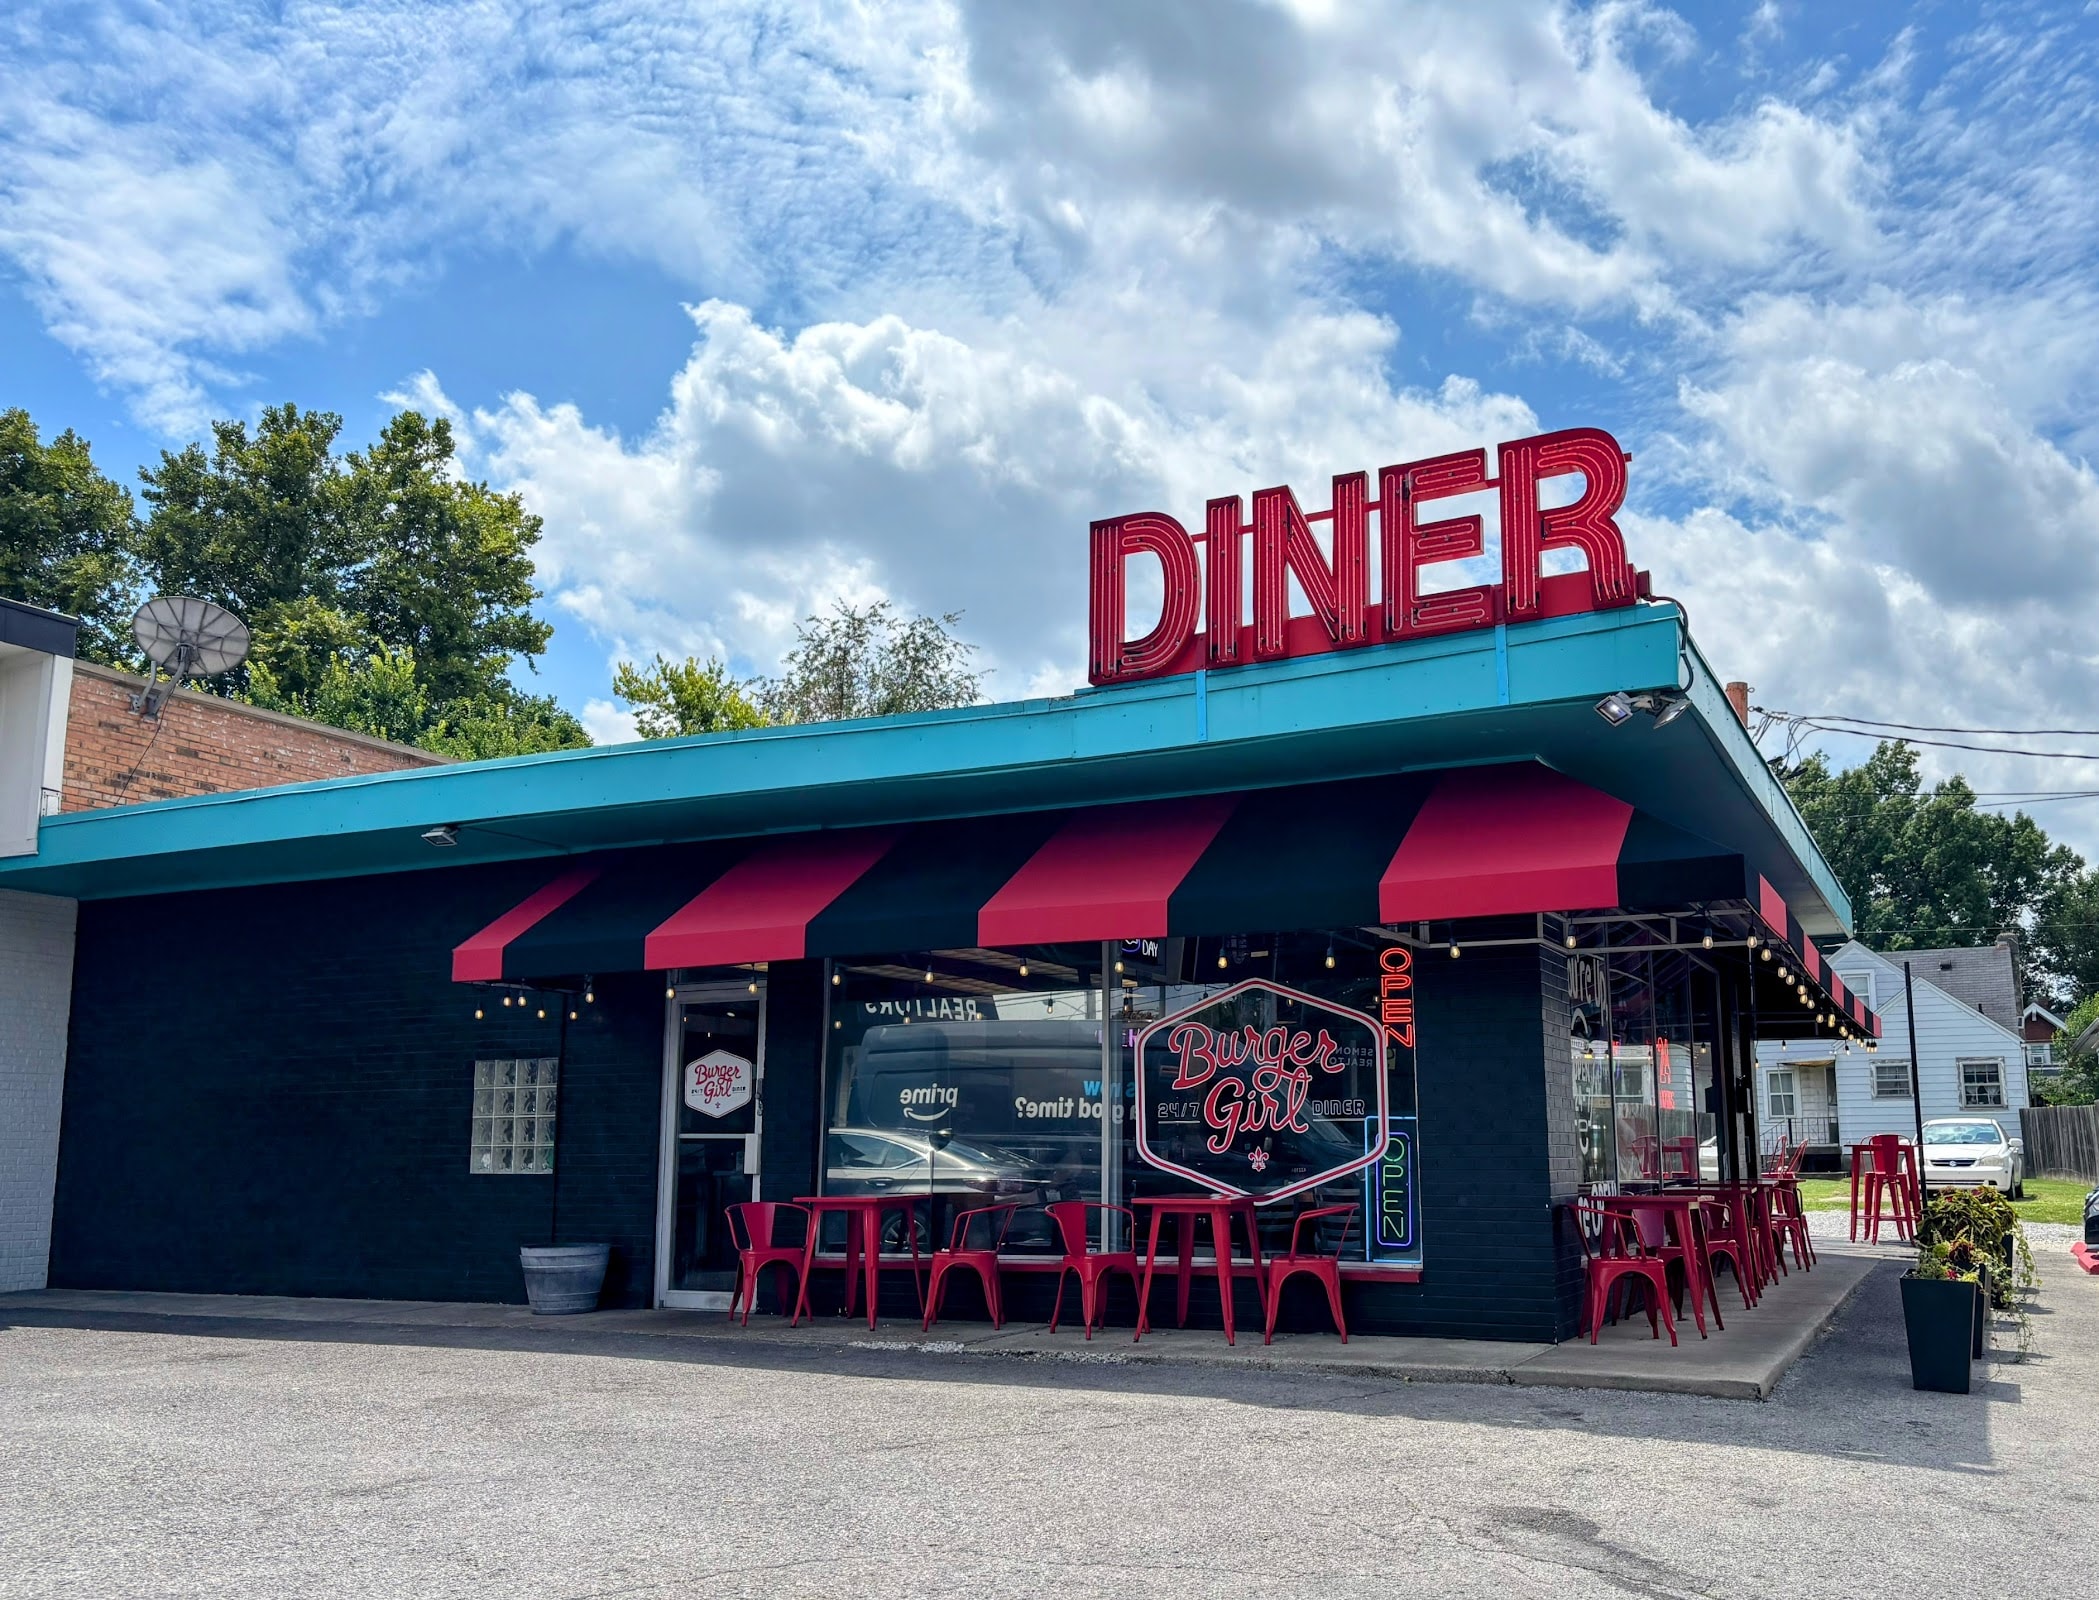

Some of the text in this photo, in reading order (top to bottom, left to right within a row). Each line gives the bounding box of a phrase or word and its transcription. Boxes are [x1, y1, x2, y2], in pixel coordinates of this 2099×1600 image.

[1089, 427, 1637, 686] DINER
[1142, 939, 1158, 957] DAY
[1380, 948, 1412, 1047] OPEN
[695, 1064, 741, 1086] Burger
[1168, 1022, 1345, 1093] Burger
[704, 1077, 733, 1104] Girl
[1157, 1102, 1200, 1118] 24/7
[1203, 1066, 1312, 1155] Girl
[1312, 1099, 1365, 1115] DINER
[1382, 1137, 1405, 1239] OPEN
